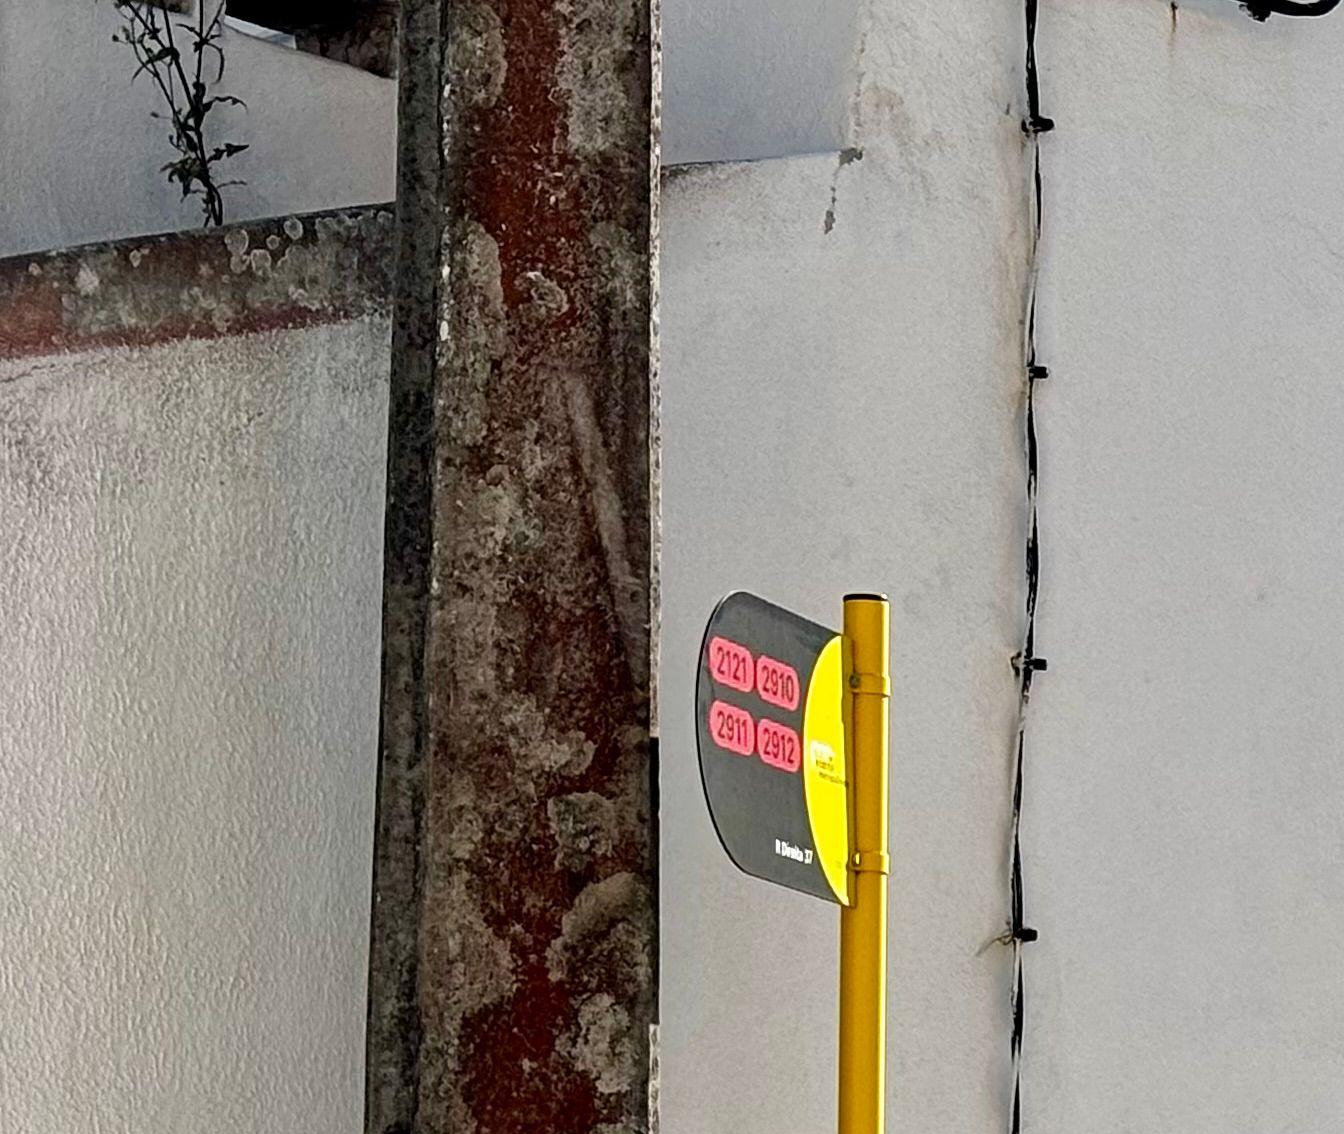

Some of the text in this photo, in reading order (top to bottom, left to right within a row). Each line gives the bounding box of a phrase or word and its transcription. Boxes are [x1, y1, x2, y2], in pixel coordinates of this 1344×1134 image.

[717, 646, 794, 702] 2121 2910
[717, 711, 747, 748] 2911
[763, 728, 795, 764] 2912
